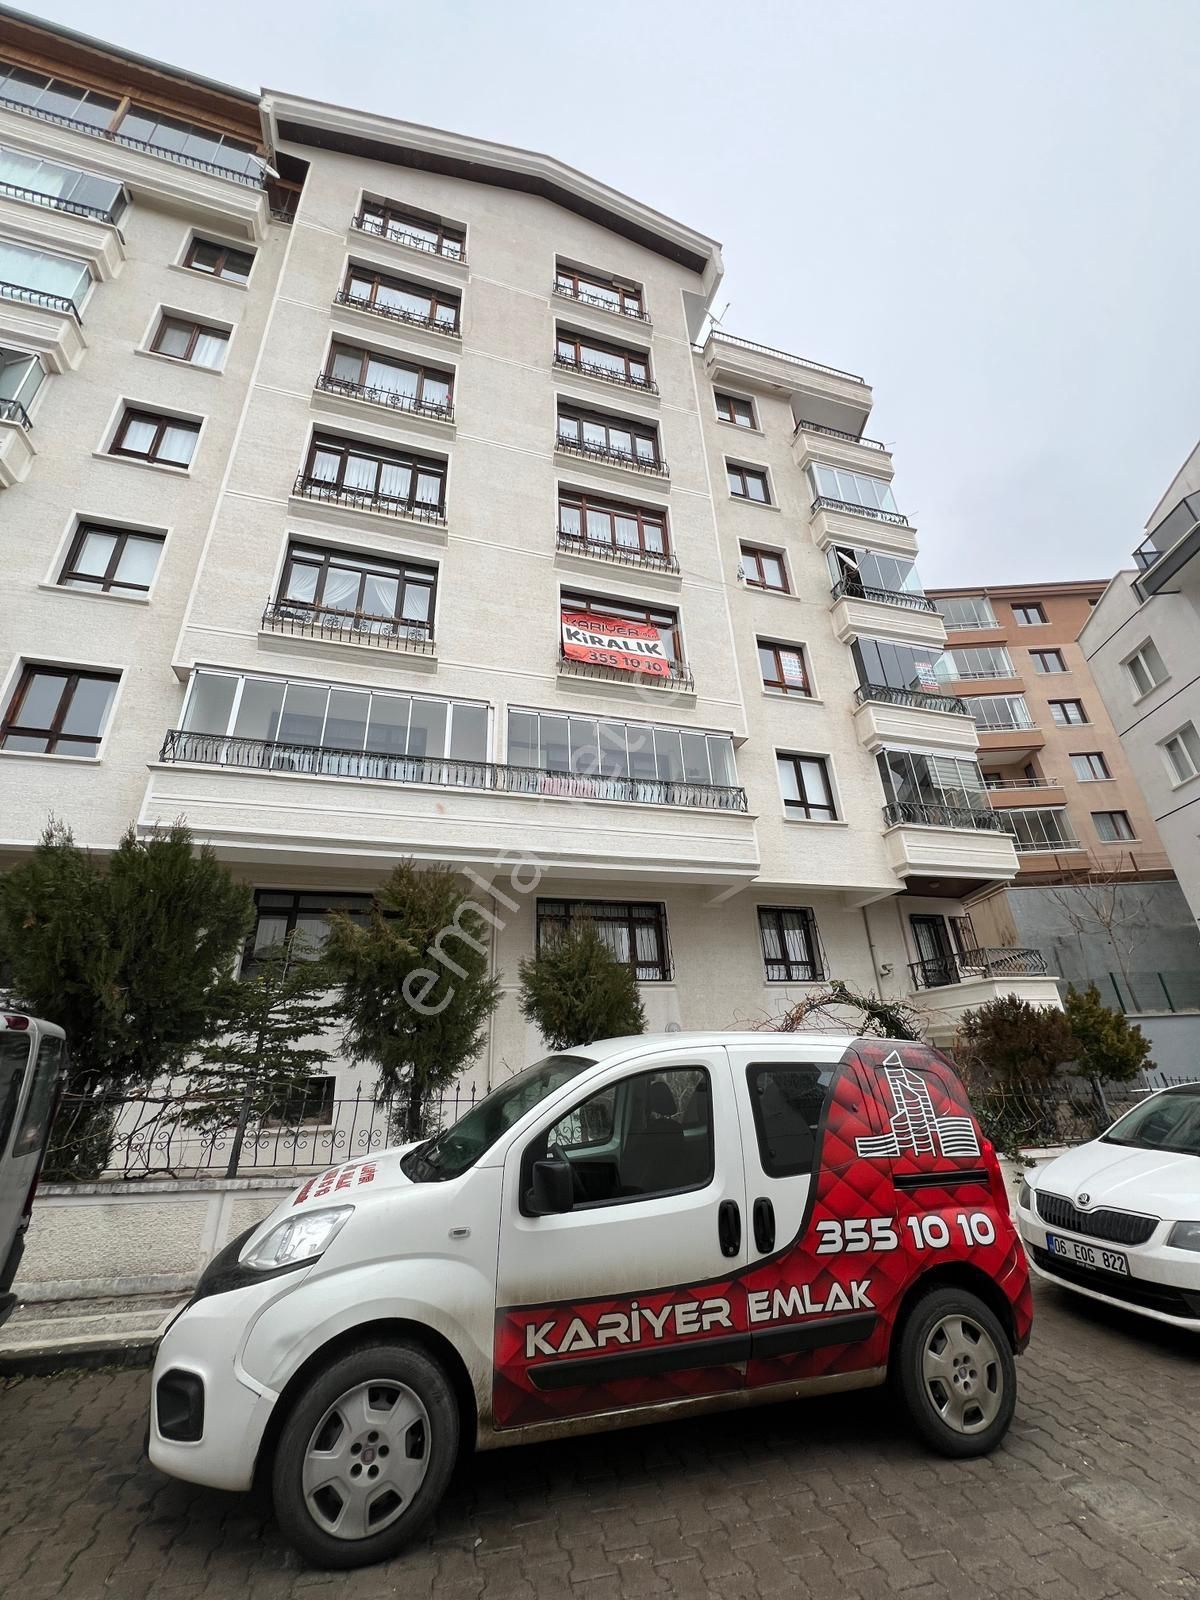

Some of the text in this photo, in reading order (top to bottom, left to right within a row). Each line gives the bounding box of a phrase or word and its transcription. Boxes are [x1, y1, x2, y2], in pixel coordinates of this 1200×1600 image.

[589, 651, 618, 666] 355
[622, 657, 641, 669] 10
[815, 1211, 997, 1254] 355 10 10
[1054, 1237, 1067, 1256] 06
[1074, 1244, 1095, 1264] EOG
[1102, 1252, 1127, 1273] 822
[525, 1279, 876, 1359] KARİYER EMLAK
